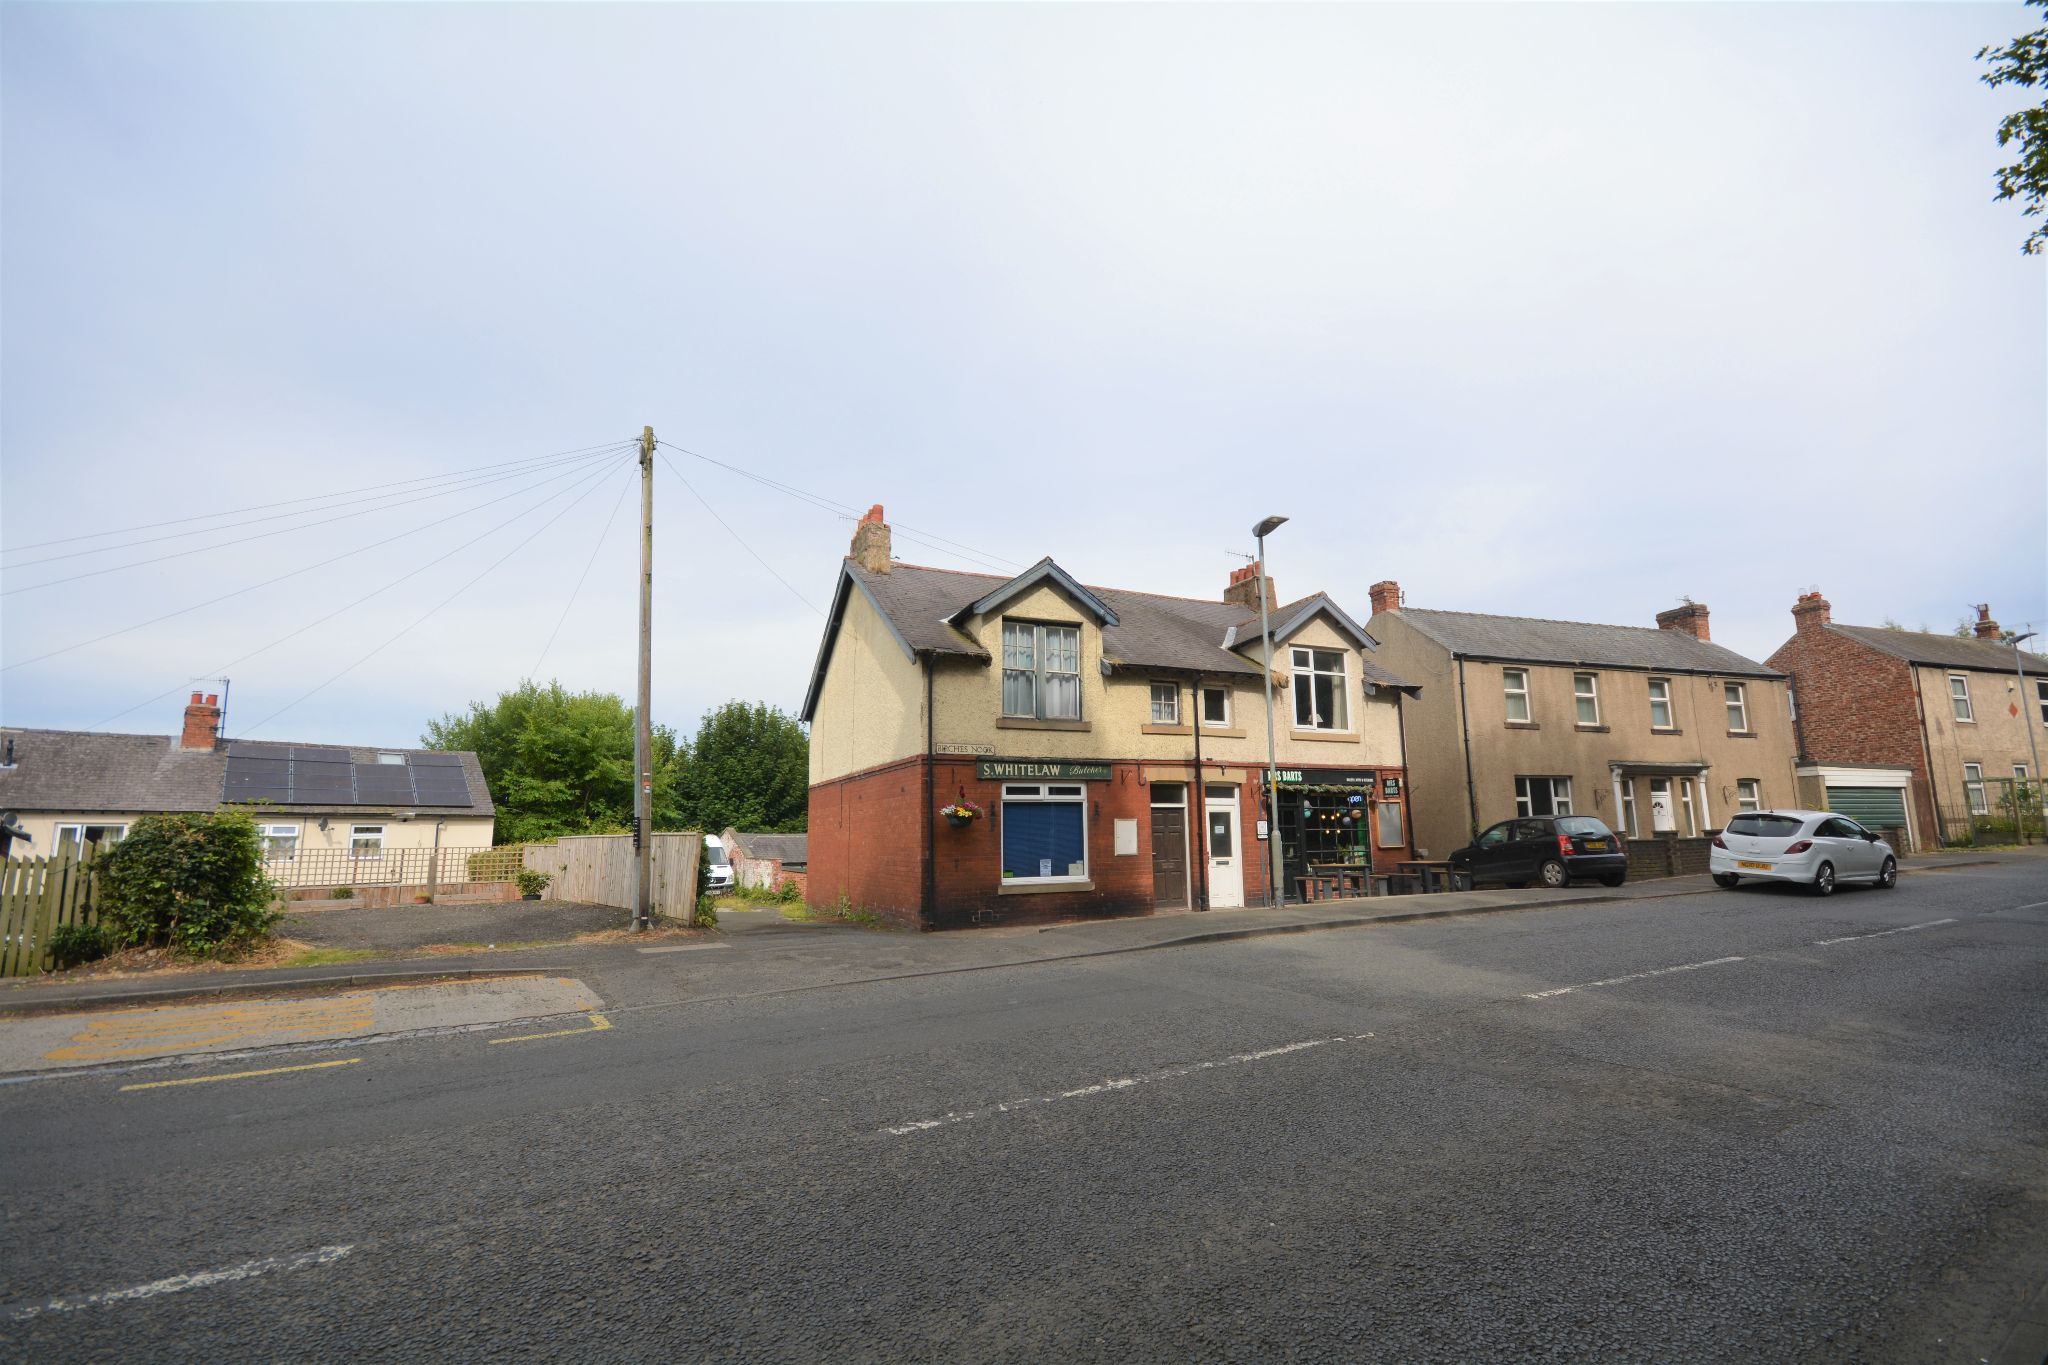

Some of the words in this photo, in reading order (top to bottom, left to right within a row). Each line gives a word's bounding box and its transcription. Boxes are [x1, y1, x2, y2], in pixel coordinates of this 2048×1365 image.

[937, 744, 969, 753] BIRCHES
[971, 745, 994, 754] NOOK
[1282, 770, 1302, 782] BARTS
